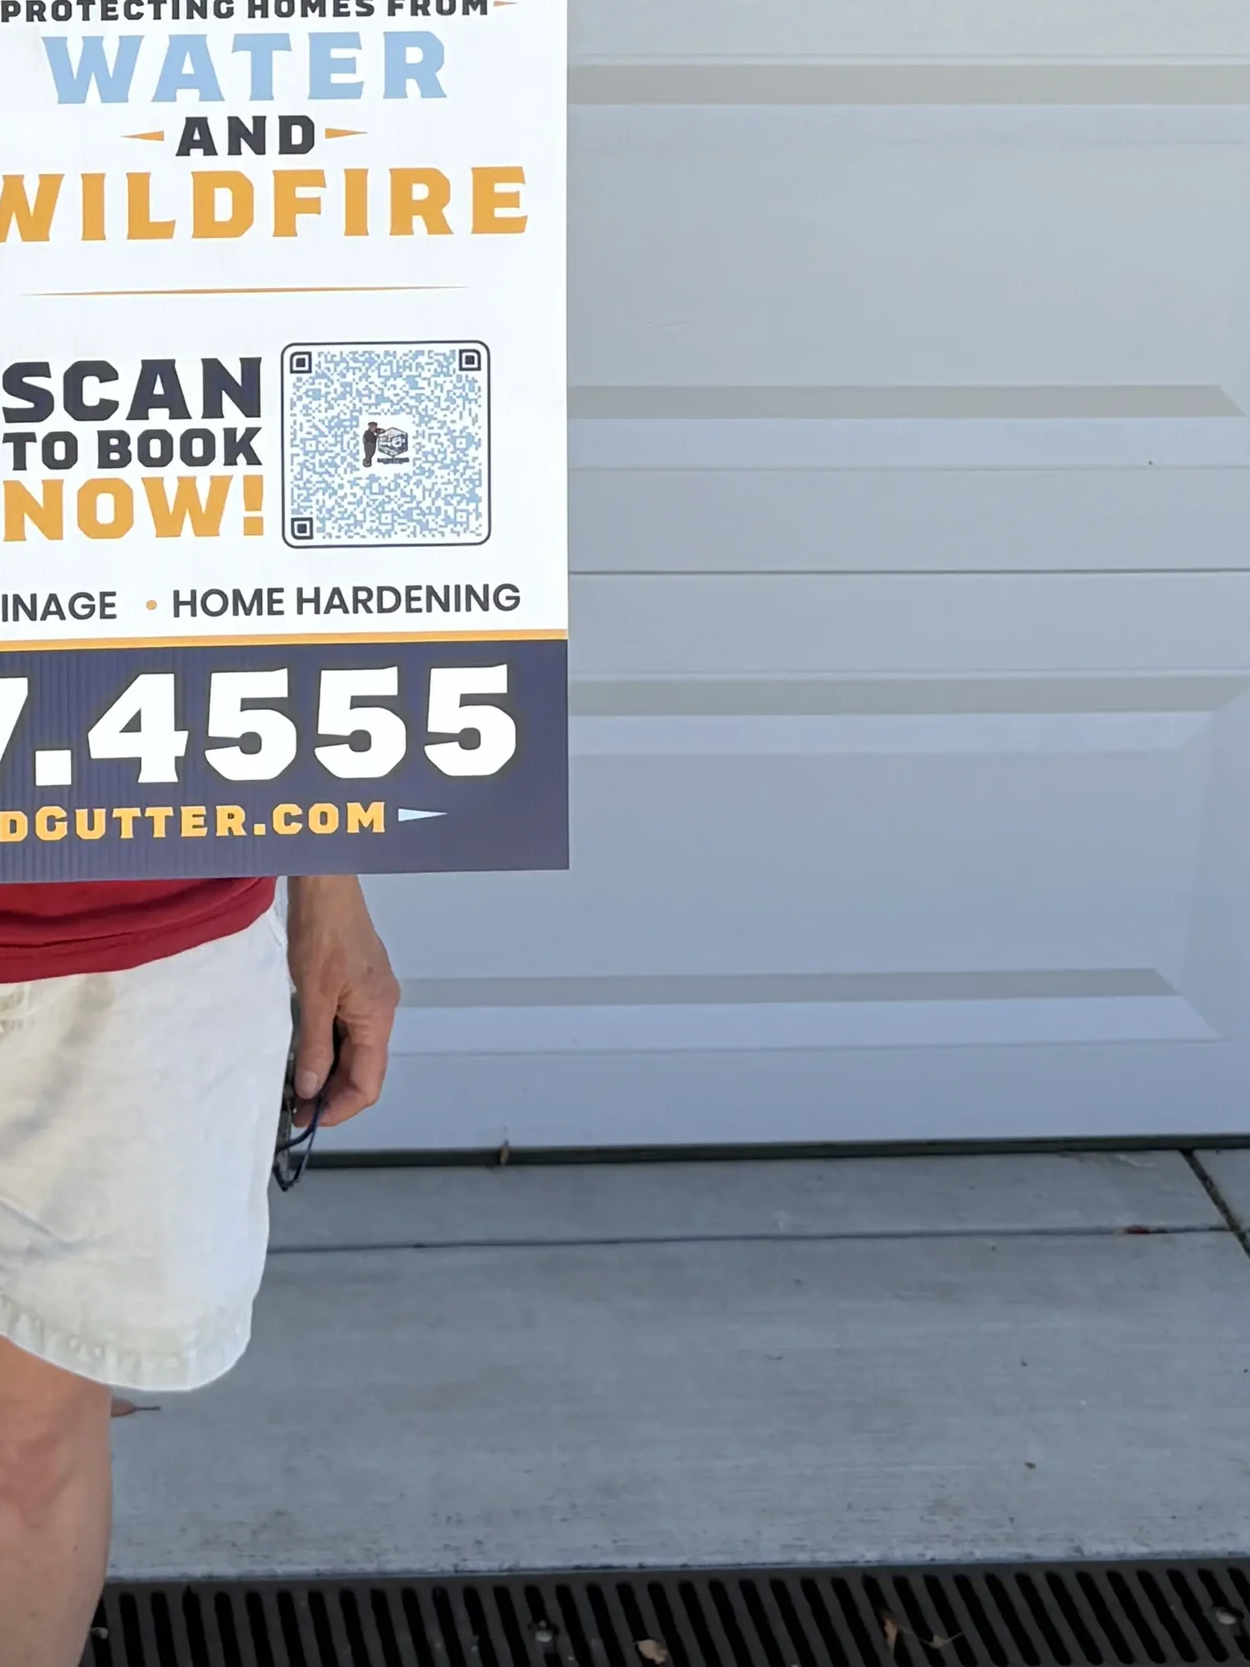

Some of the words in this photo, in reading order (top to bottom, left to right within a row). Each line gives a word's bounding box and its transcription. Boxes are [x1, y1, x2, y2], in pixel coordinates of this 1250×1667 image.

[40, 31, 448, 104] WATER
[175, 114, 315, 157] AND
[1, 356, 263, 424] SCAN
[2, 430, 79, 472] TO
[96, 426, 263, 470] BOOK
[3, 474, 264, 543] NOW!
[172, 587, 285, 618] HOME
[296, 583, 521, 616] HARDENING
